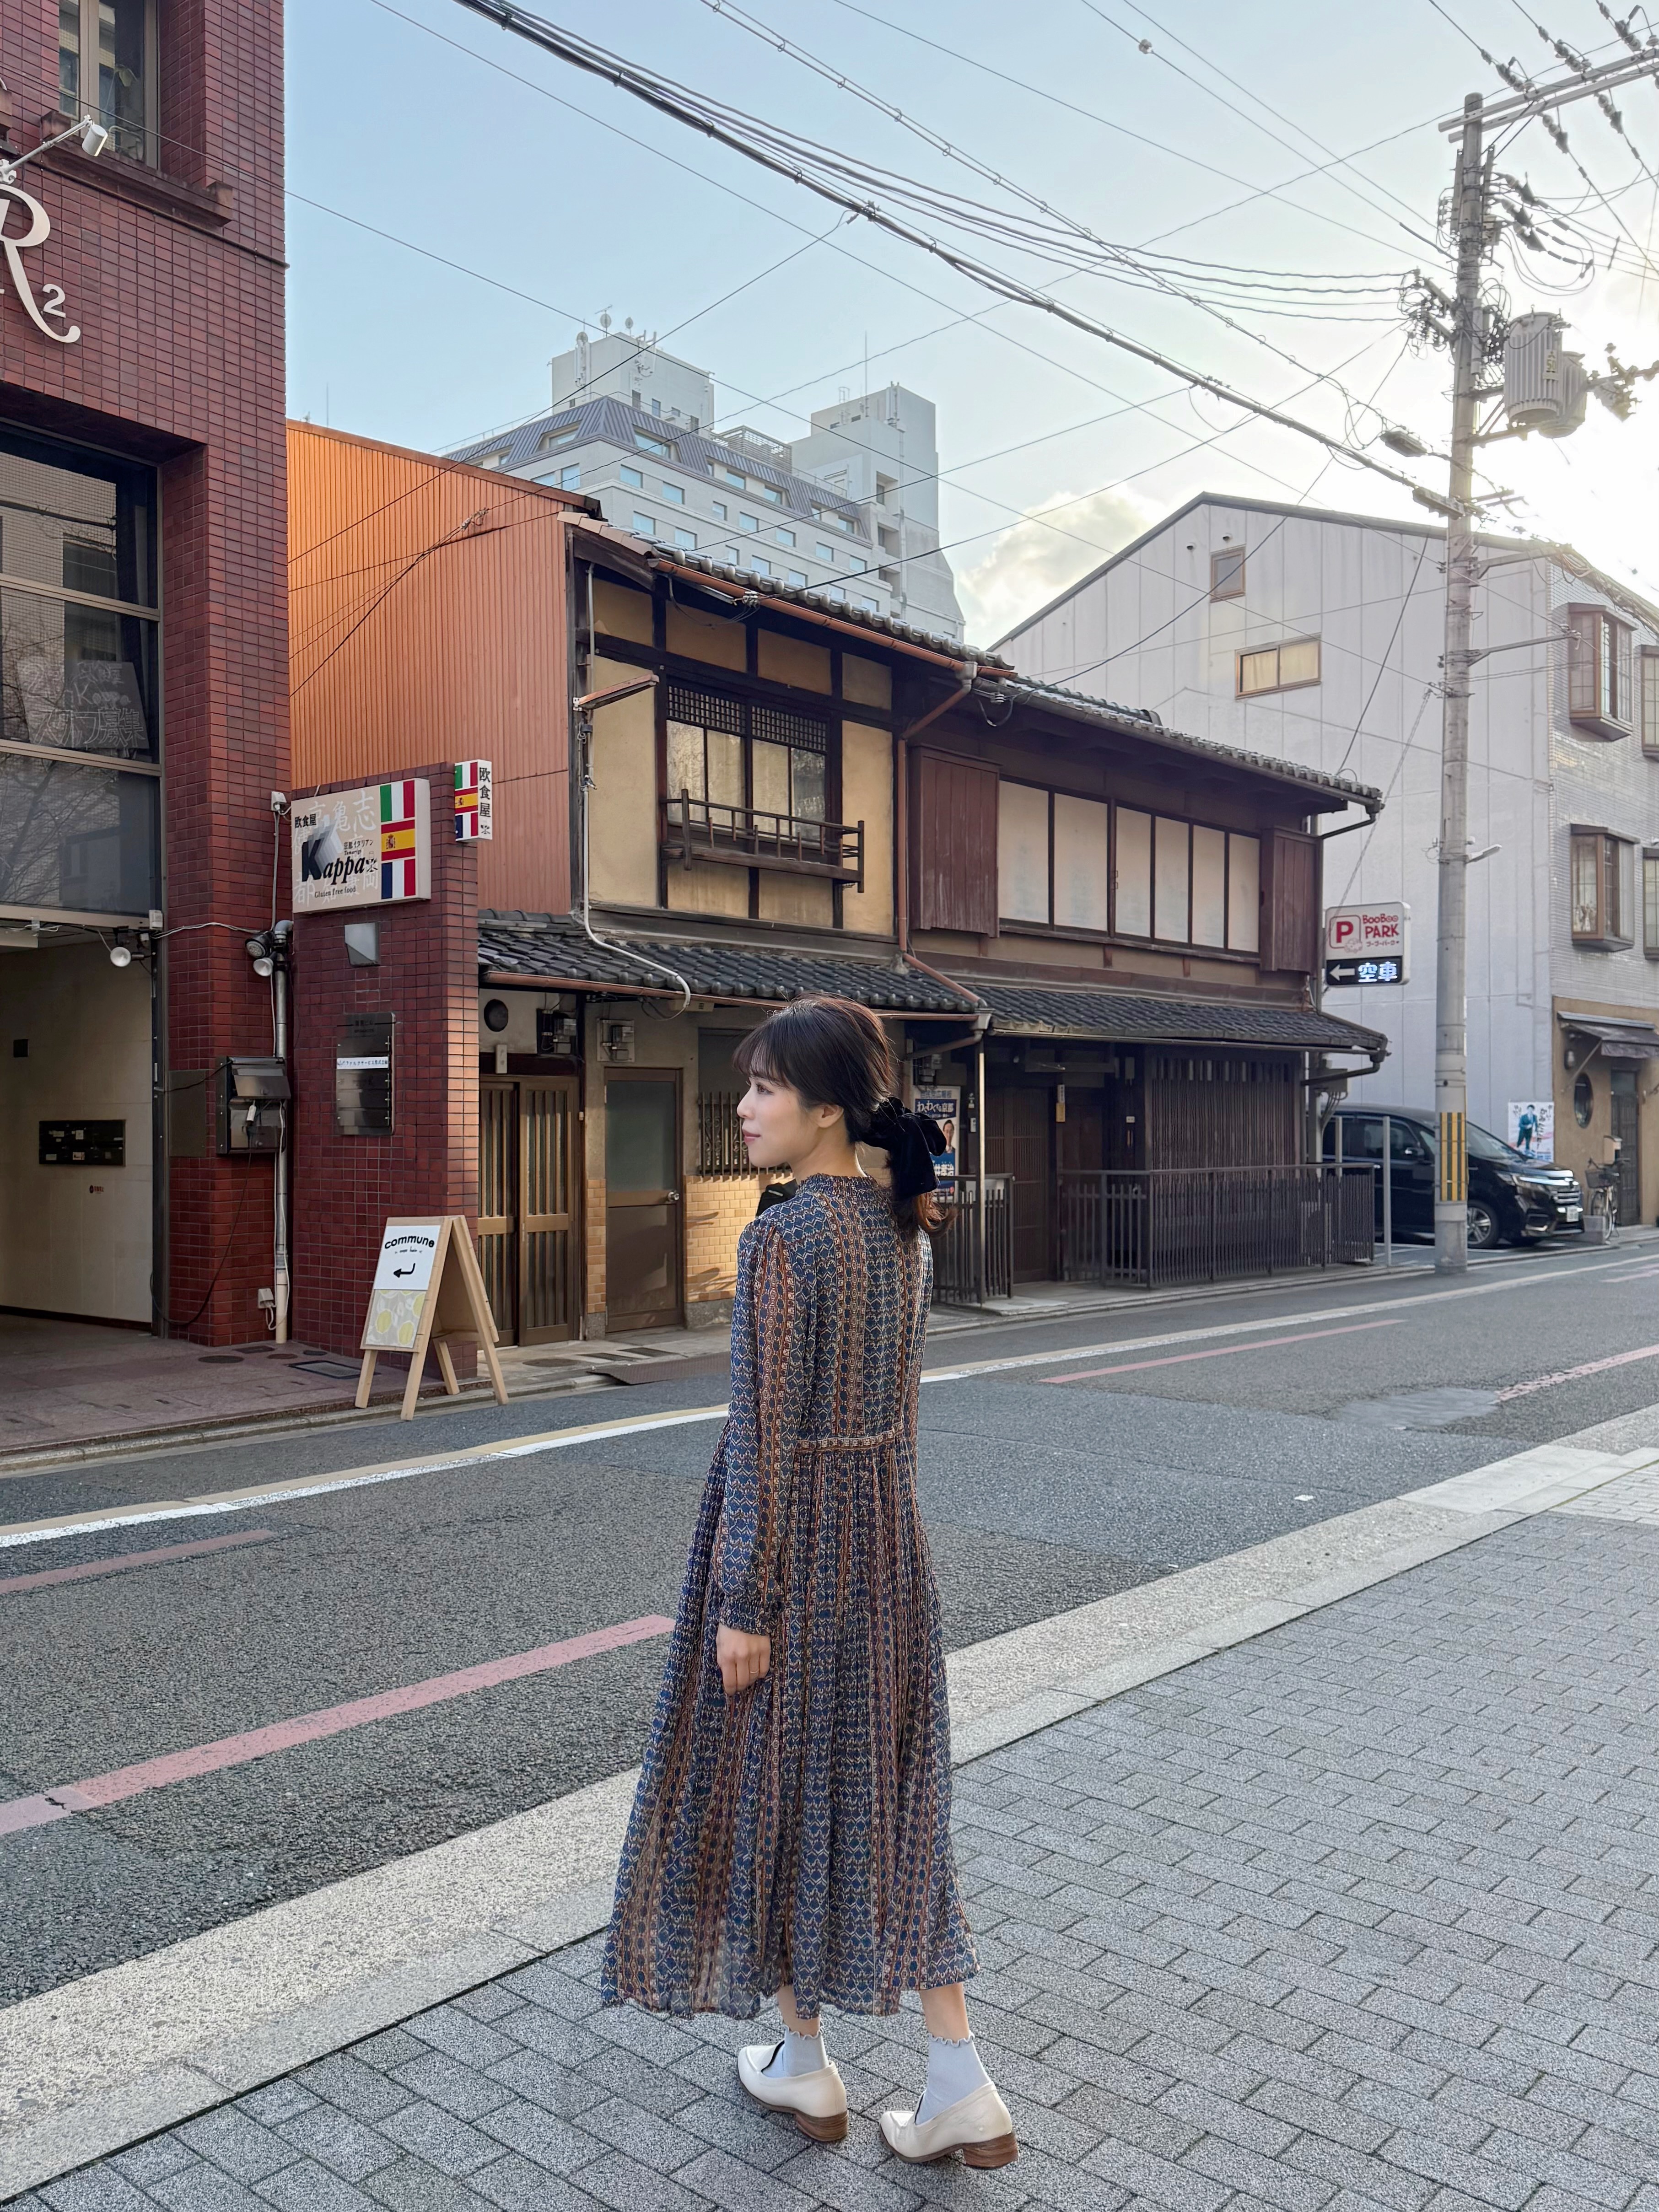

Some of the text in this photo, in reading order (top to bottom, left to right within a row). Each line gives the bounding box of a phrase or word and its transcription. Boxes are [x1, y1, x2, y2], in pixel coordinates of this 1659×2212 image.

[479, 767, 491, 818] 欧食屋
[295, 813, 317, 829] 欧食屋
[302, 837, 366, 885] Kappa
[1336, 913, 1399, 943] P BooBoo
[1365, 923, 1399, 939] PARK
[1358, 961, 1398, 983] 空車
[384, 1235, 435, 1249] commune
